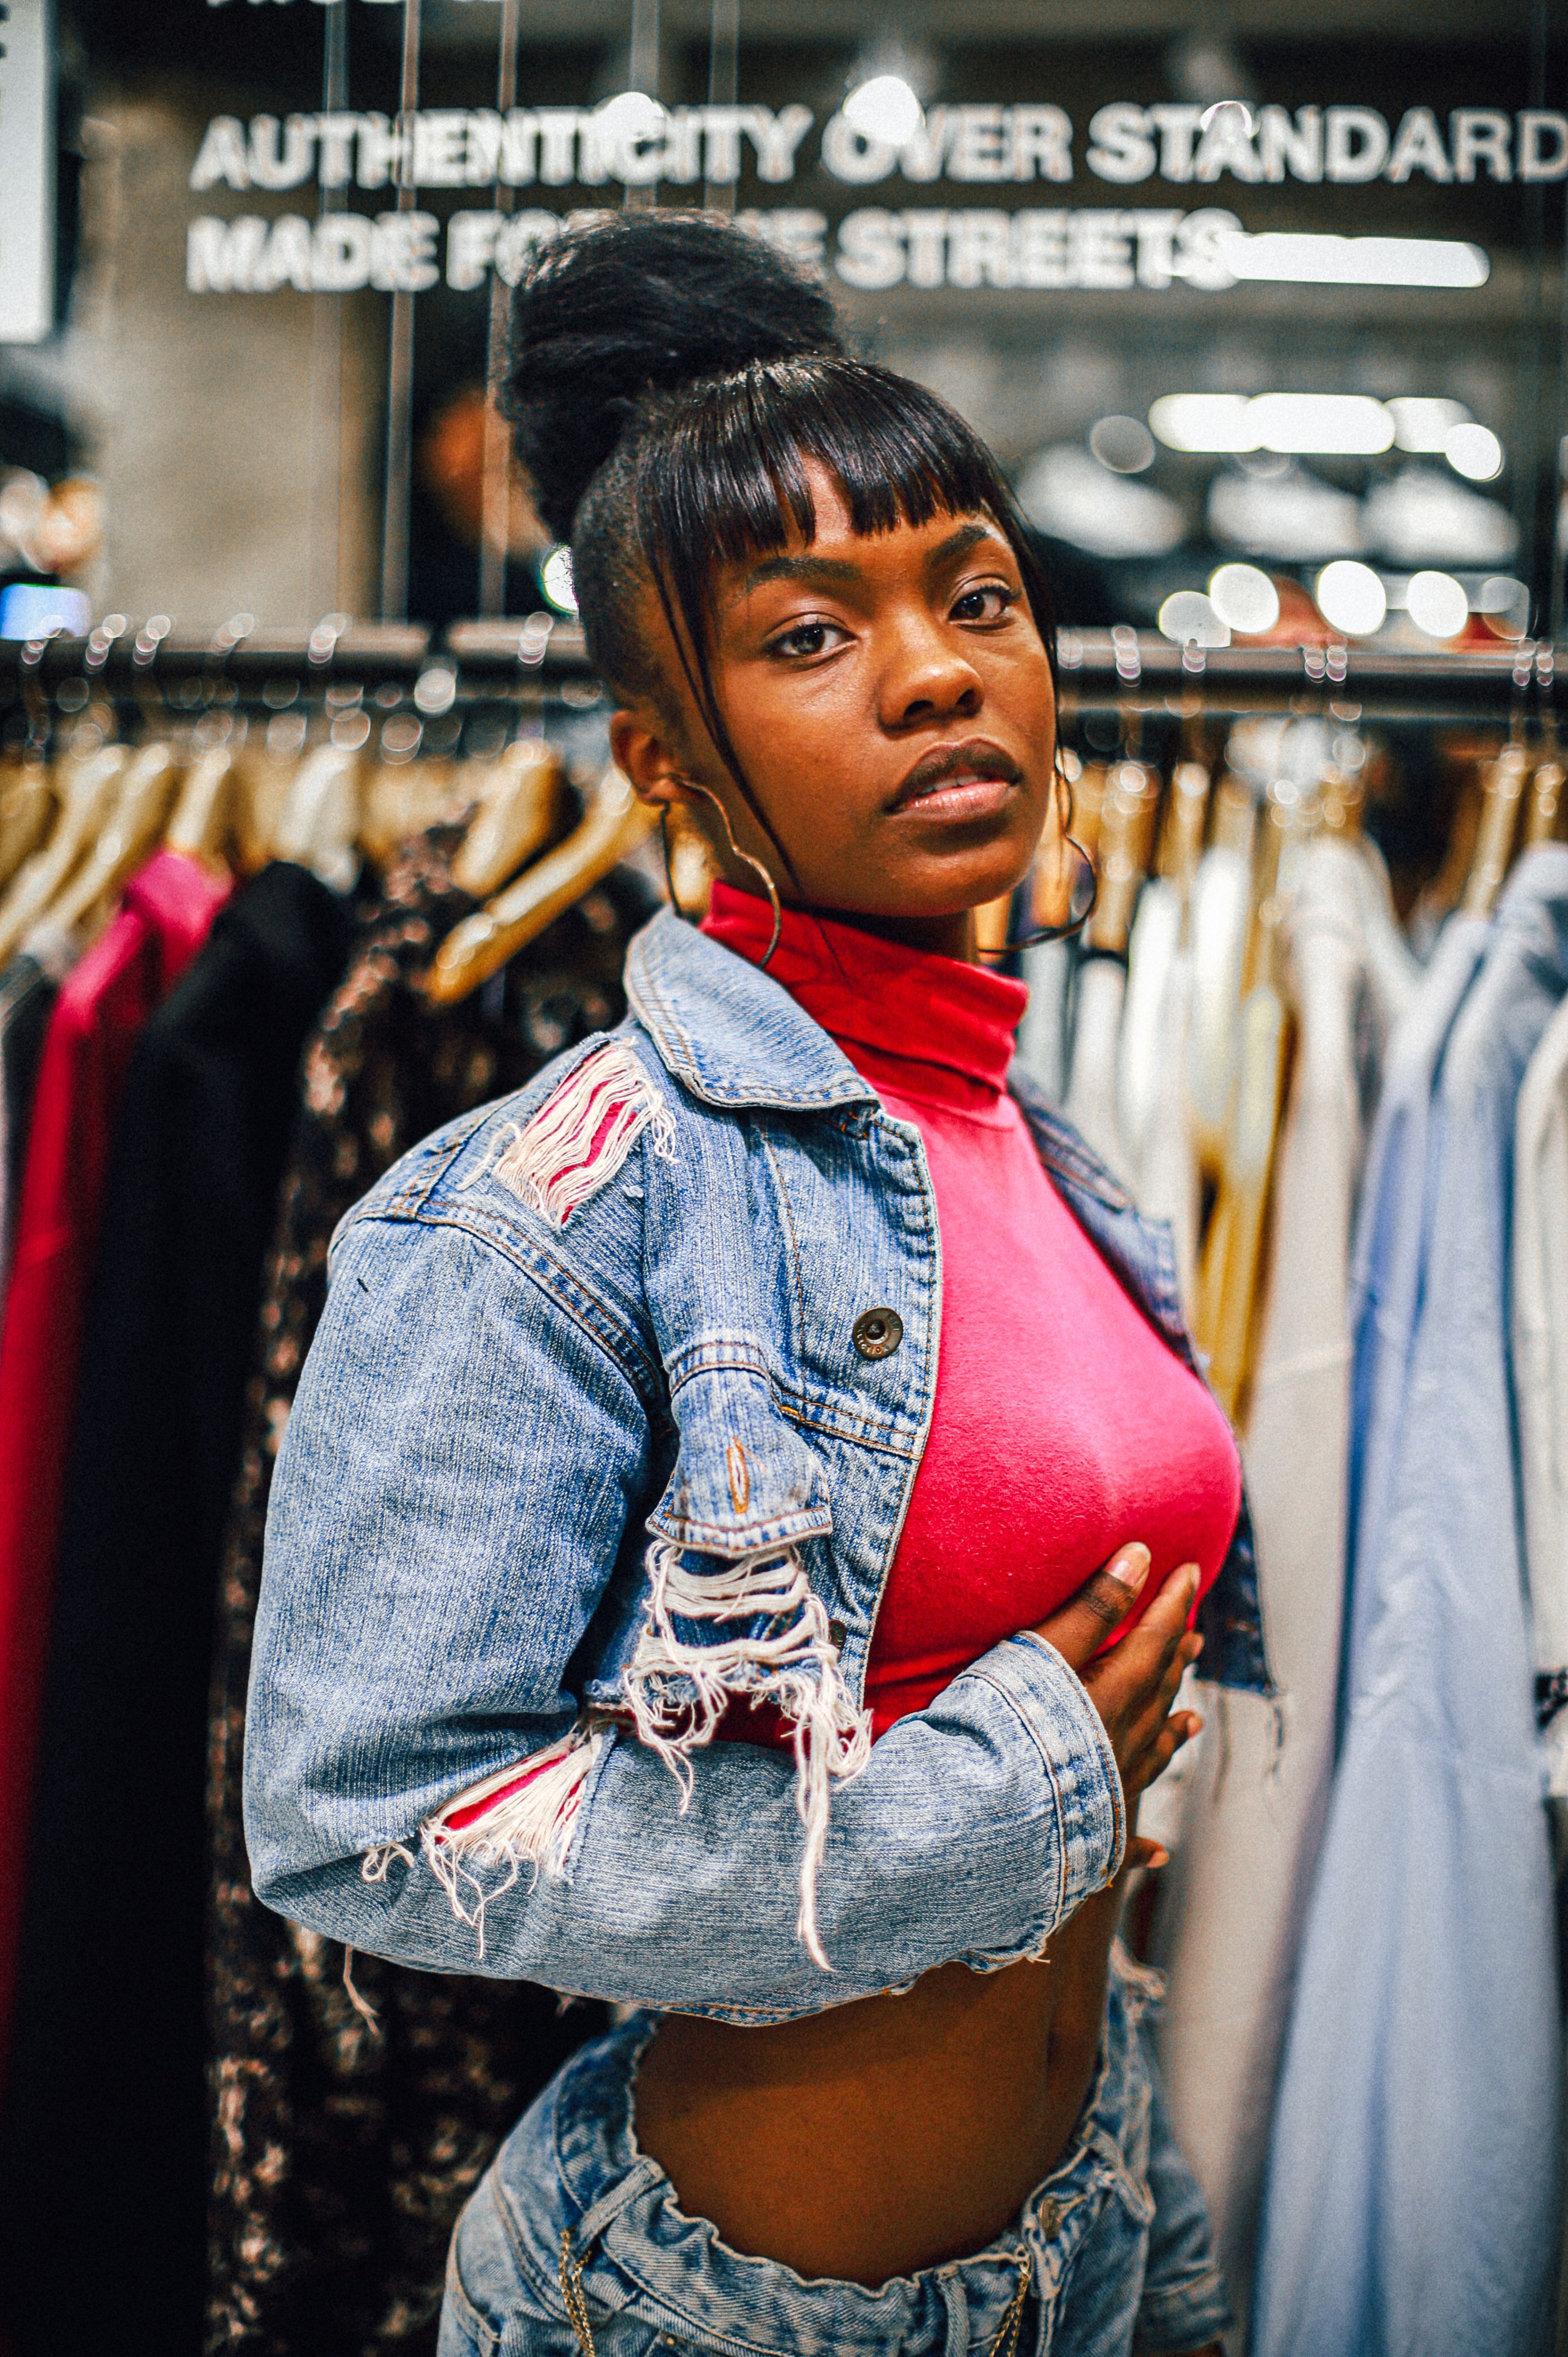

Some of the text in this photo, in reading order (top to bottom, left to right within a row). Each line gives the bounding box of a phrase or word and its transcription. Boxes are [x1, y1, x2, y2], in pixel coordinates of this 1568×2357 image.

[190, 102, 1568, 190] AUTHENTICITY OVER STANDARD
[187, 212, 440, 292] MADE
[447, 207, 584, 291] FO
[835, 207, 1244, 290] STREETS
